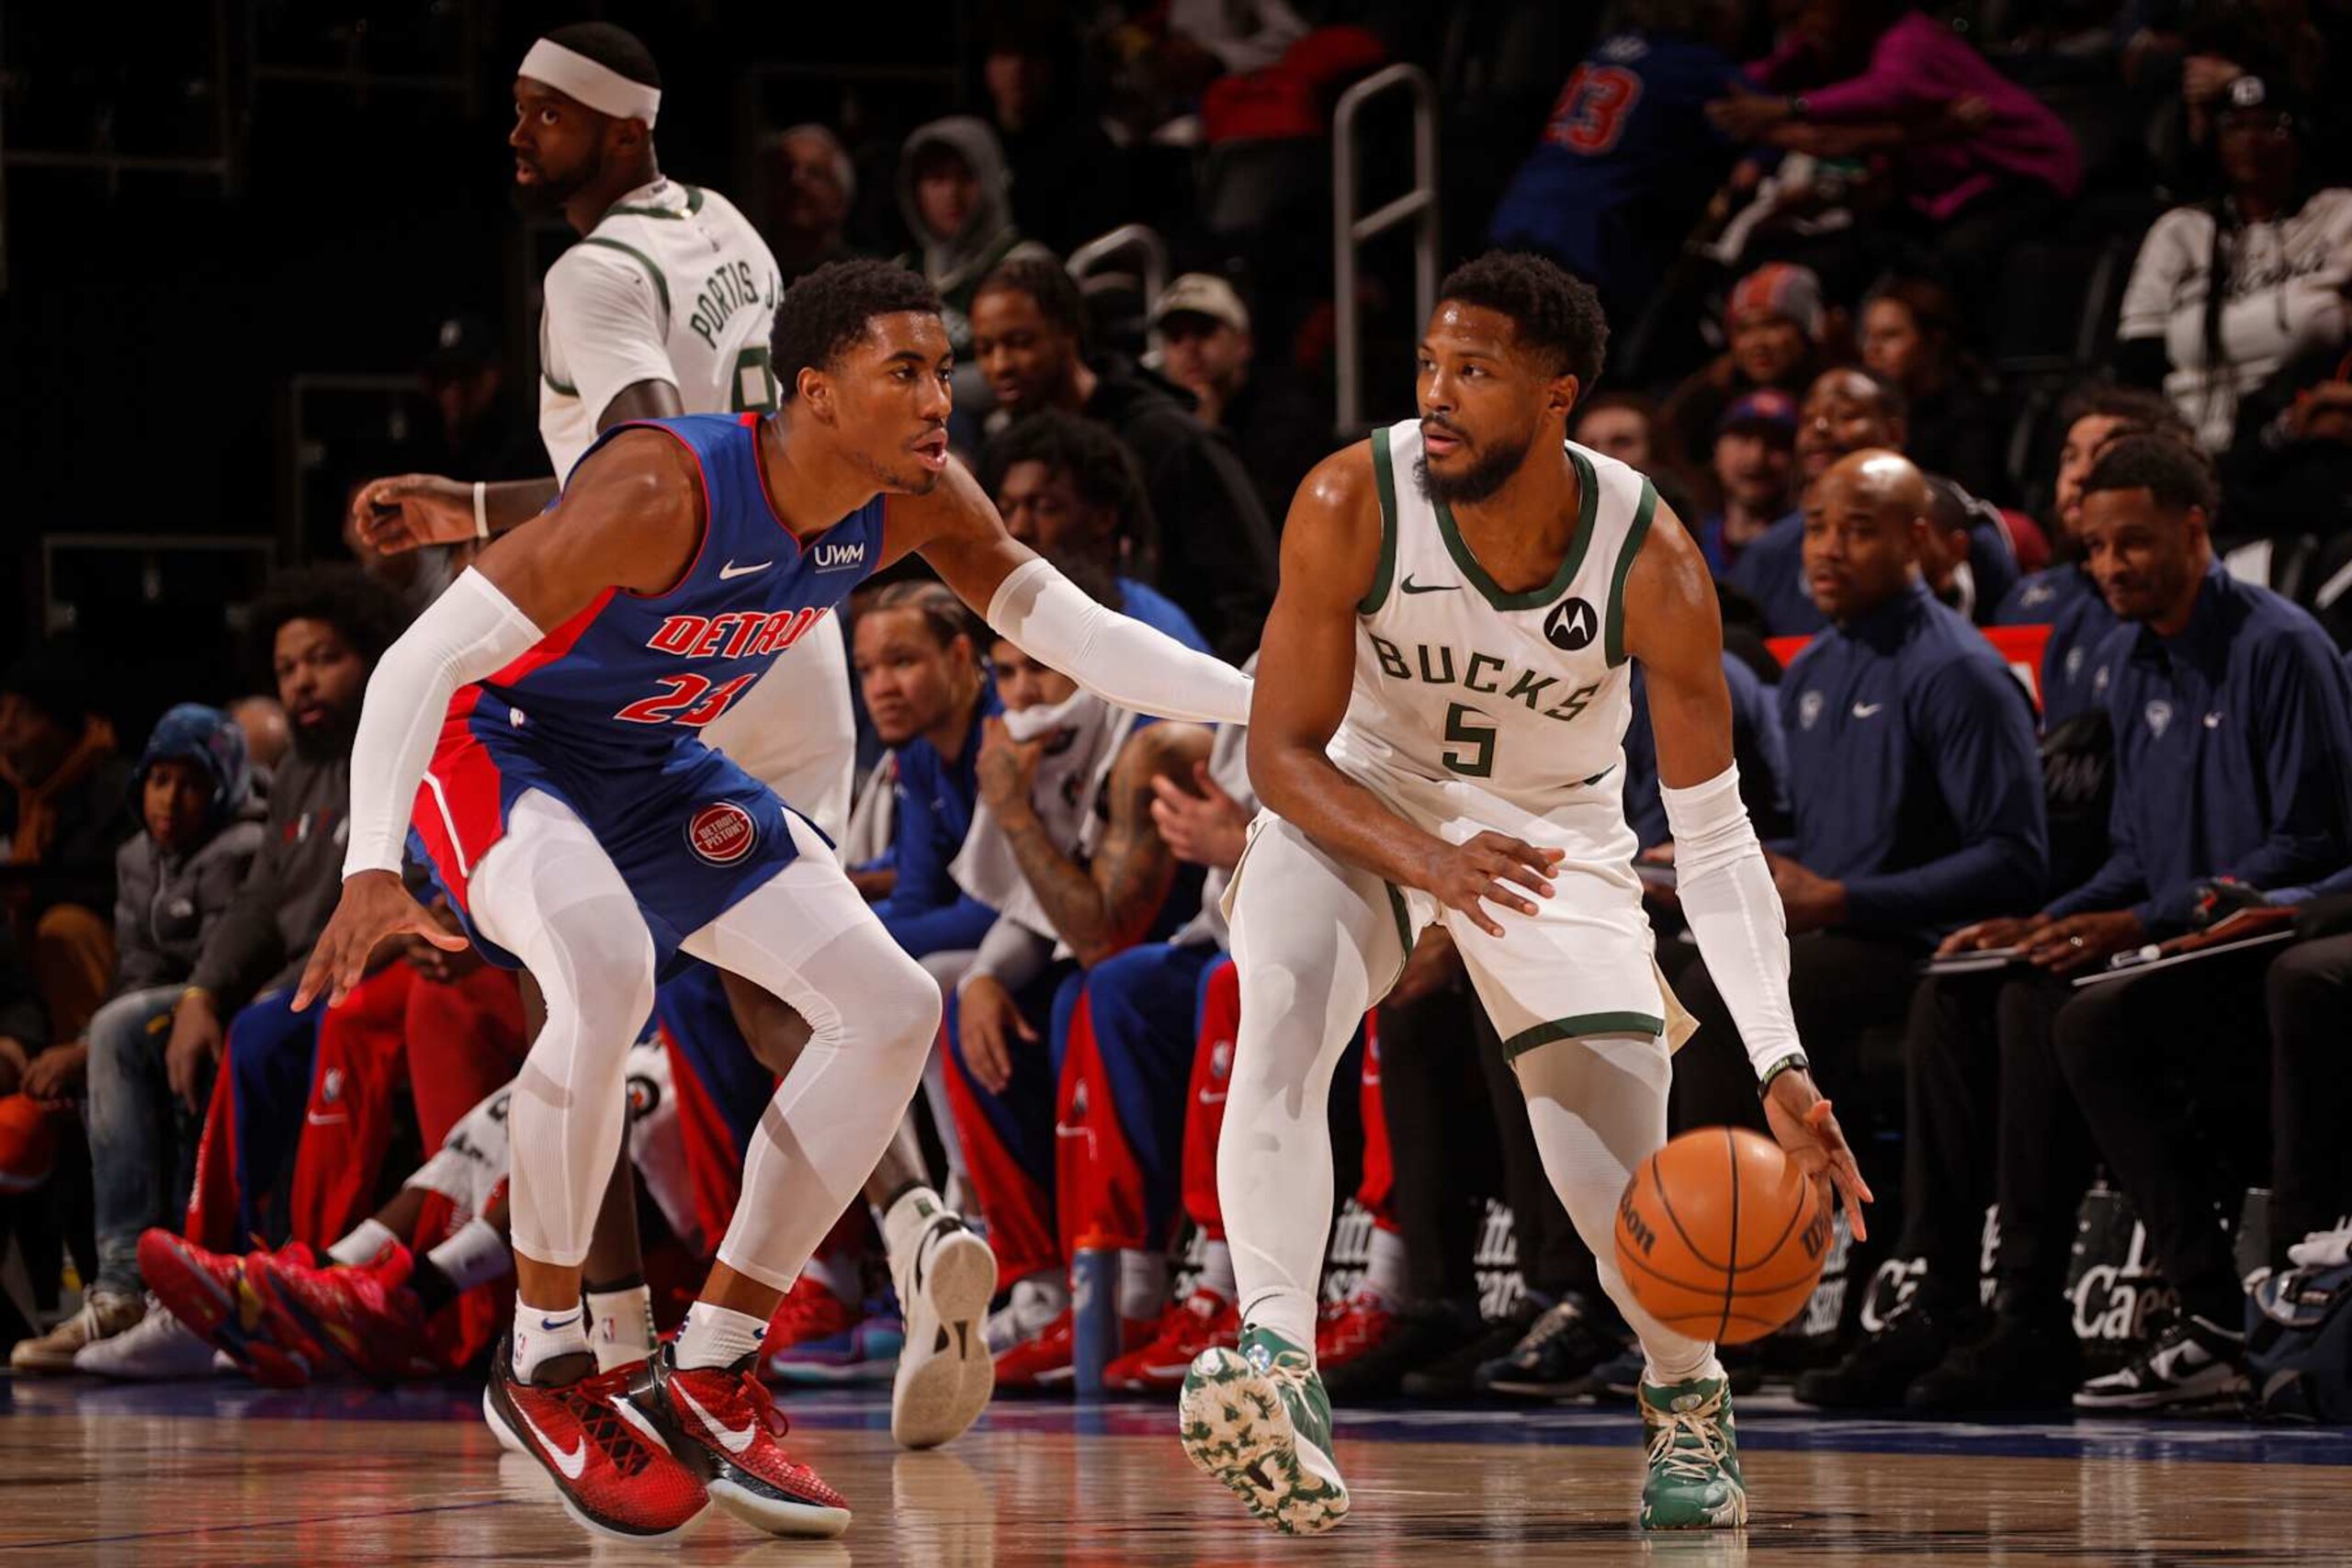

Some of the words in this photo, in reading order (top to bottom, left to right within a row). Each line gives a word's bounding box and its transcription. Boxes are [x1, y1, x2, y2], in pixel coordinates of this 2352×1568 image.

[690, 261, 759, 351] PORTIS
[814, 542, 865, 568] UWM
[613, 672, 758, 728] 23
[1369, 634, 1600, 721] BUCKS
[1442, 702, 1502, 778] 5
[698, 811, 739, 840] DETROIT
[704, 820, 746, 850] PISTONS
